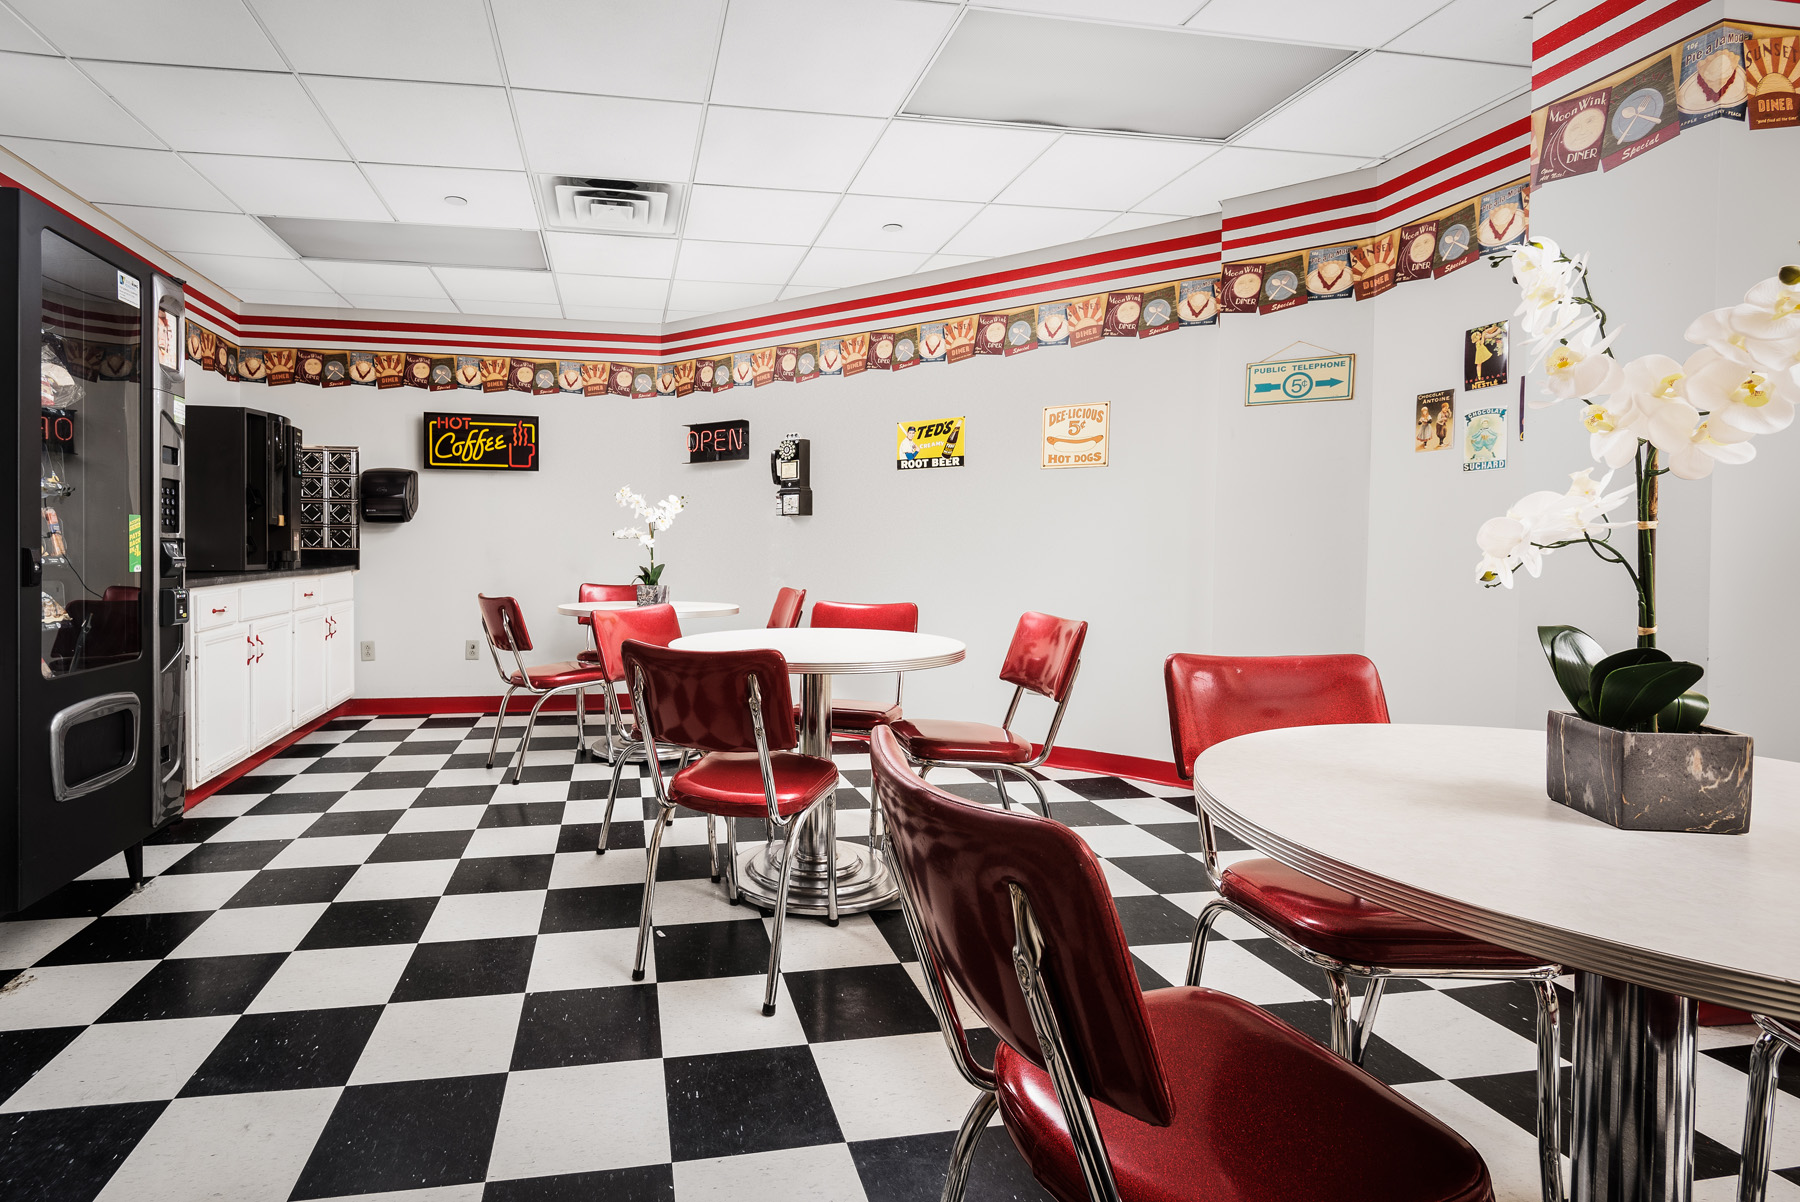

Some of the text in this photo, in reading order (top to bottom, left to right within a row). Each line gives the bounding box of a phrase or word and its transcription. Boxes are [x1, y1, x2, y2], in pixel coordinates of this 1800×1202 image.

[1685, 33, 1749, 67] Pie a la Mode
[1746, 43, 1798, 69] SUNSET
[1549, 92, 1607, 123] Moon Wink
[1758, 98, 1794, 112] DINER
[1728, 110, 1742, 118] PEACH
[1622, 134, 1660, 160] Special
[1566, 148, 1598, 164] DINER
[1402, 222, 1436, 240] Moon Wink
[1352, 242, 1392, 266] SUNSET
[1224, 268, 1244, 277] Moon
[1244, 265, 1262, 274] Wink
[1412, 260, 1431, 270] DINER
[1444, 256, 1468, 272] Special
[1362, 274, 1390, 290] DINER
[1109, 295, 1125, 304] Moon
[1126, 294, 1141, 302] Wink
[1271, 300, 1296, 311] Special
[1076, 328, 1097, 339] DINER
[1149, 325, 1169, 336] Special
[1254, 360, 1346, 374] PUBLIC TELEPHONE
[1291, 378, 1308, 393] 5¢
[1418, 392, 1444, 400] CHOCOLAT
[1422, 396, 1450, 404] ANTOINE
[1468, 408, 1503, 418] CHOCOLAT
[438, 416, 472, 429] HOT
[1068, 420, 1086, 436] 5¢
[917, 420, 954, 440] TED'S
[435, 428, 507, 462] Coffee
[686, 428, 742, 452] OPEN
[920, 441, 945, 449] CREAMY
[901, 457, 960, 469] ROOT BEER
[1048, 452, 1102, 464] HOT DOGS
[1464, 460, 1504, 470] SUCHARD
